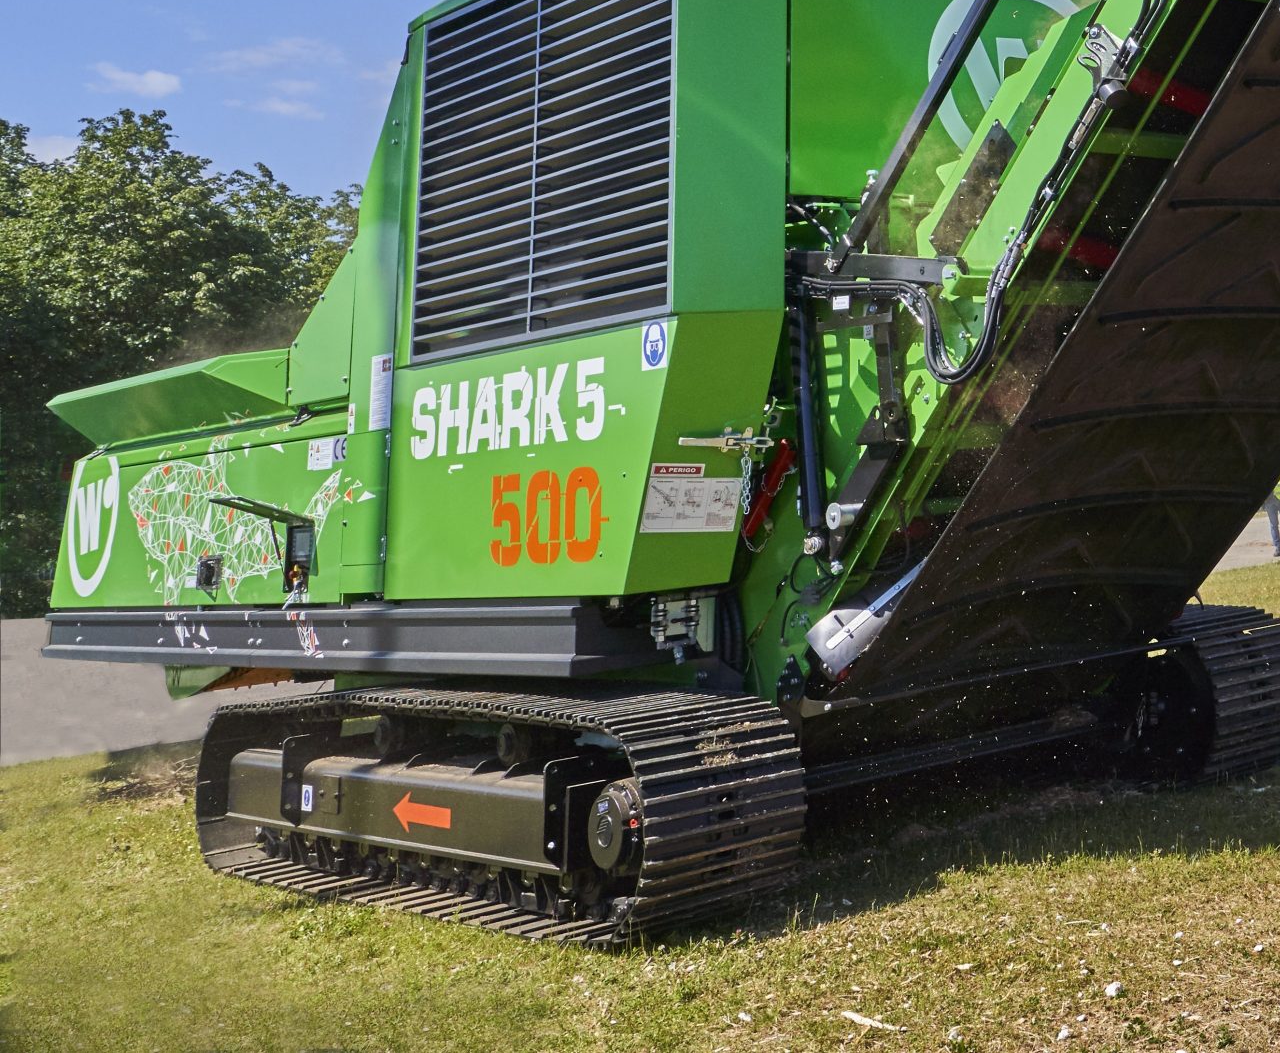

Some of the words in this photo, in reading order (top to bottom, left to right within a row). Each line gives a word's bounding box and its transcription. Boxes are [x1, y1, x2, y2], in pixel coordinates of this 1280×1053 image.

[410, 363, 570, 460] SHARK
[575, 356, 606, 442] 5
[333, 437, 348, 460] CE
[668, 466, 697, 474] PERIGO
[489, 465, 603, 568] 500
